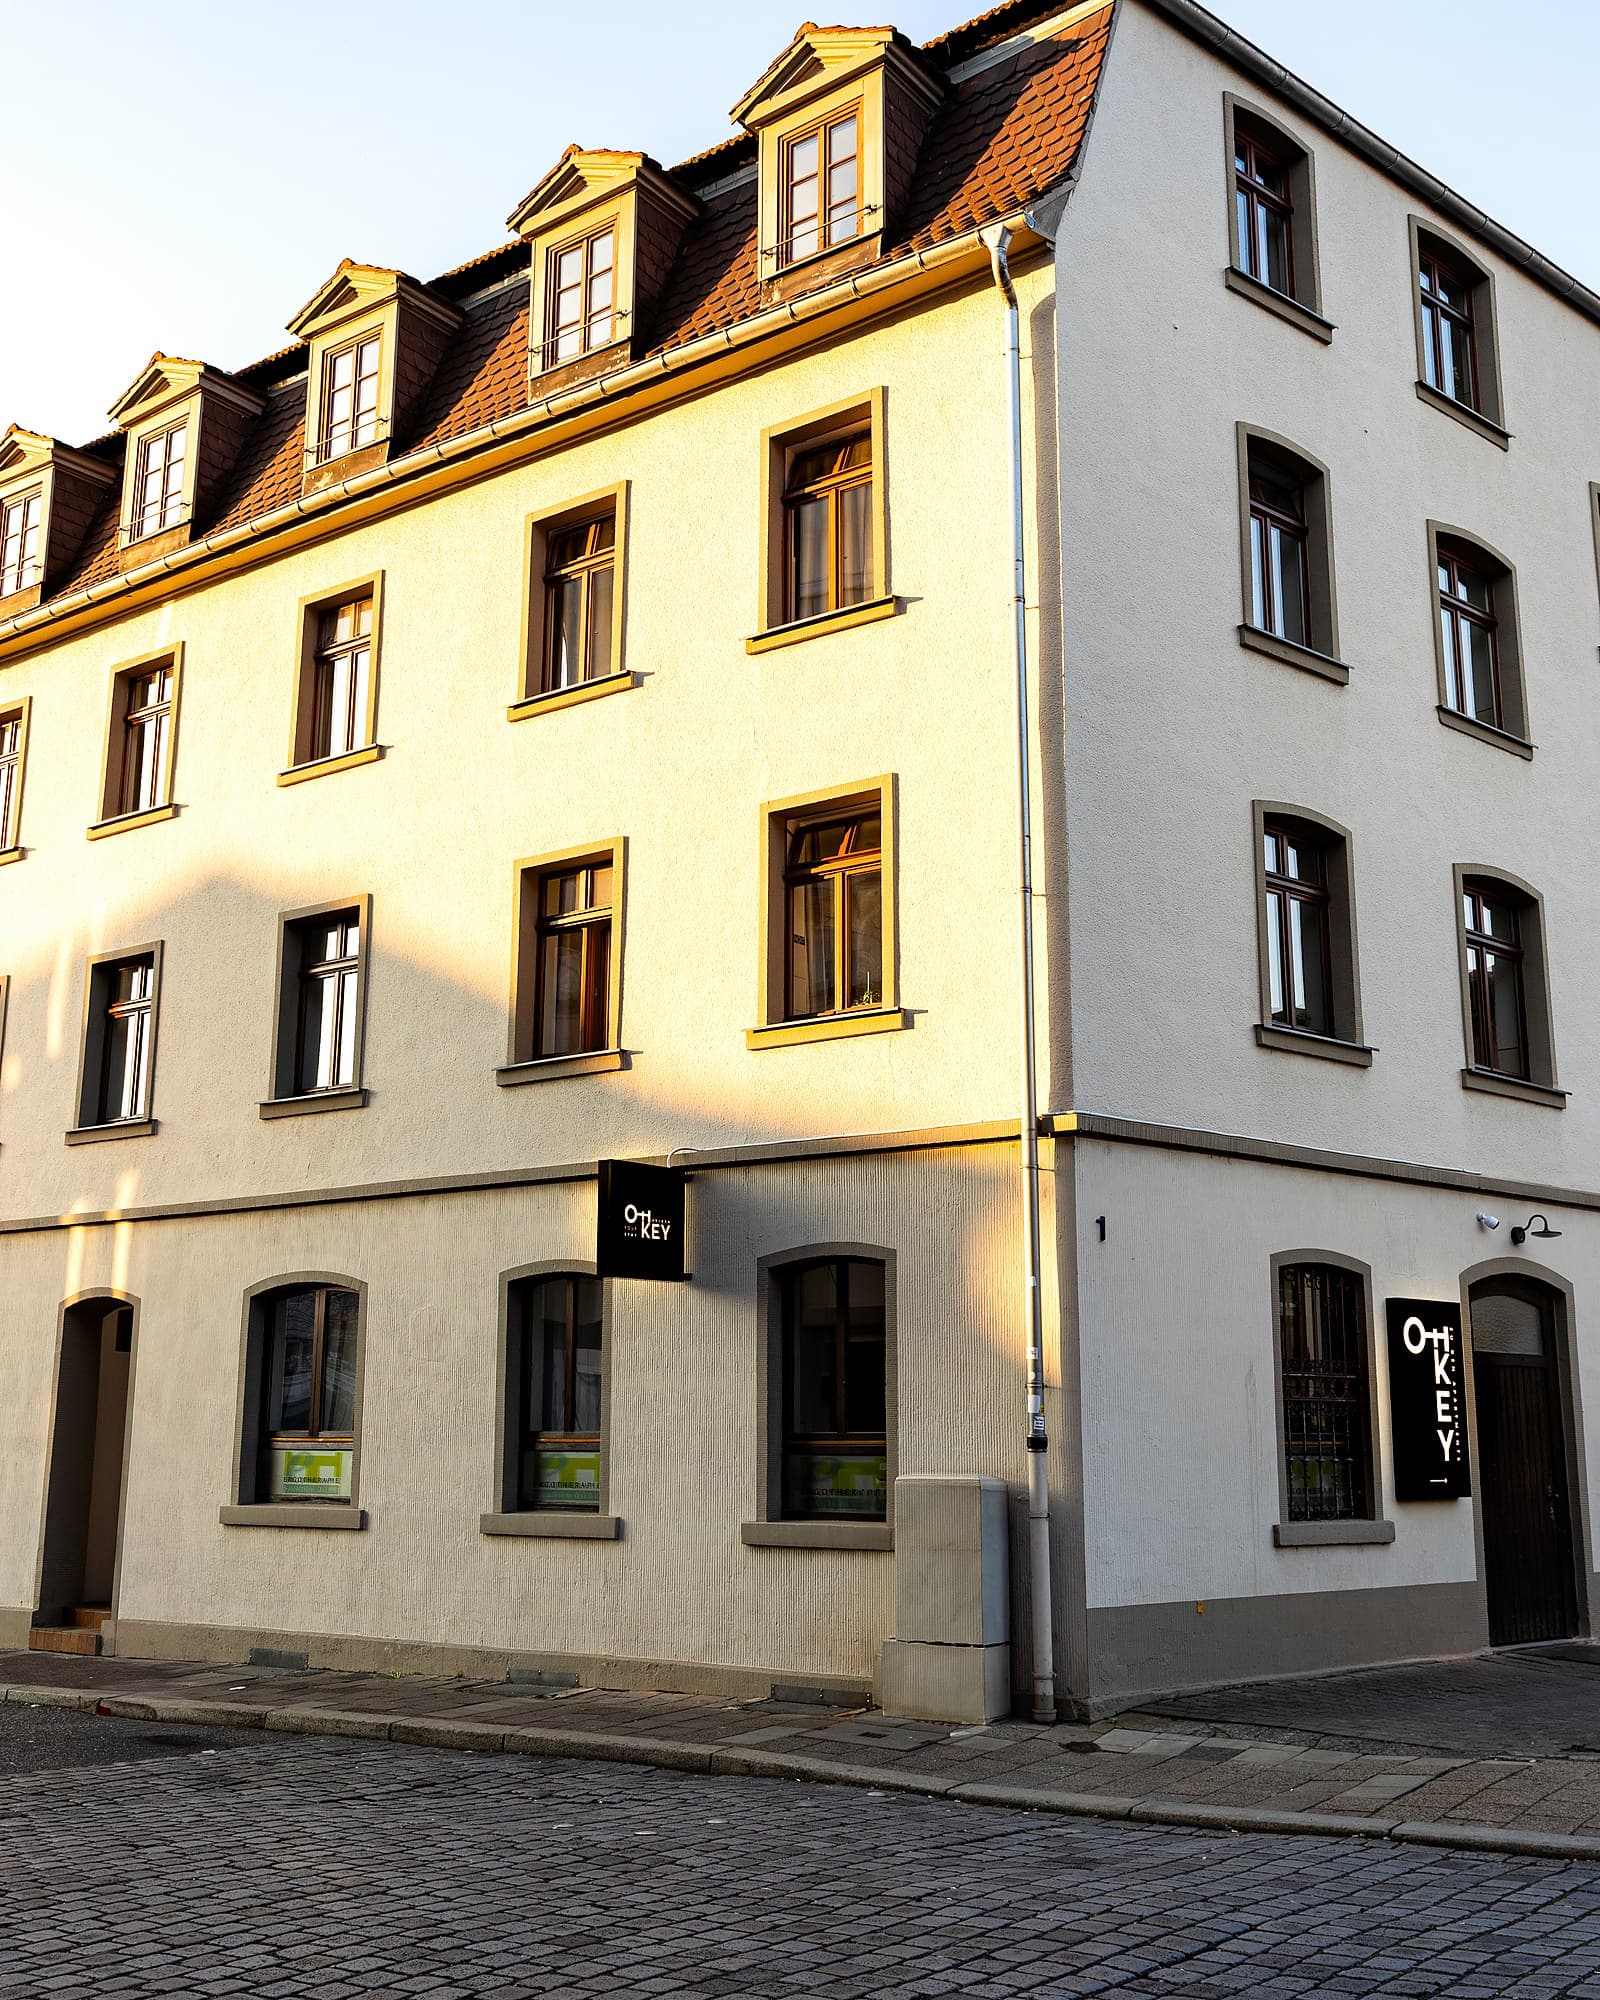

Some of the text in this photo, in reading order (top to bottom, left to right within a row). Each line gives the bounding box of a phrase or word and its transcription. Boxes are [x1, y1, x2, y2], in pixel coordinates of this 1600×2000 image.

[641, 1222, 671, 1241] KEY
[1096, 1216, 1105, 1241] 1
[1434, 1349, 1454, 1462] KEY
